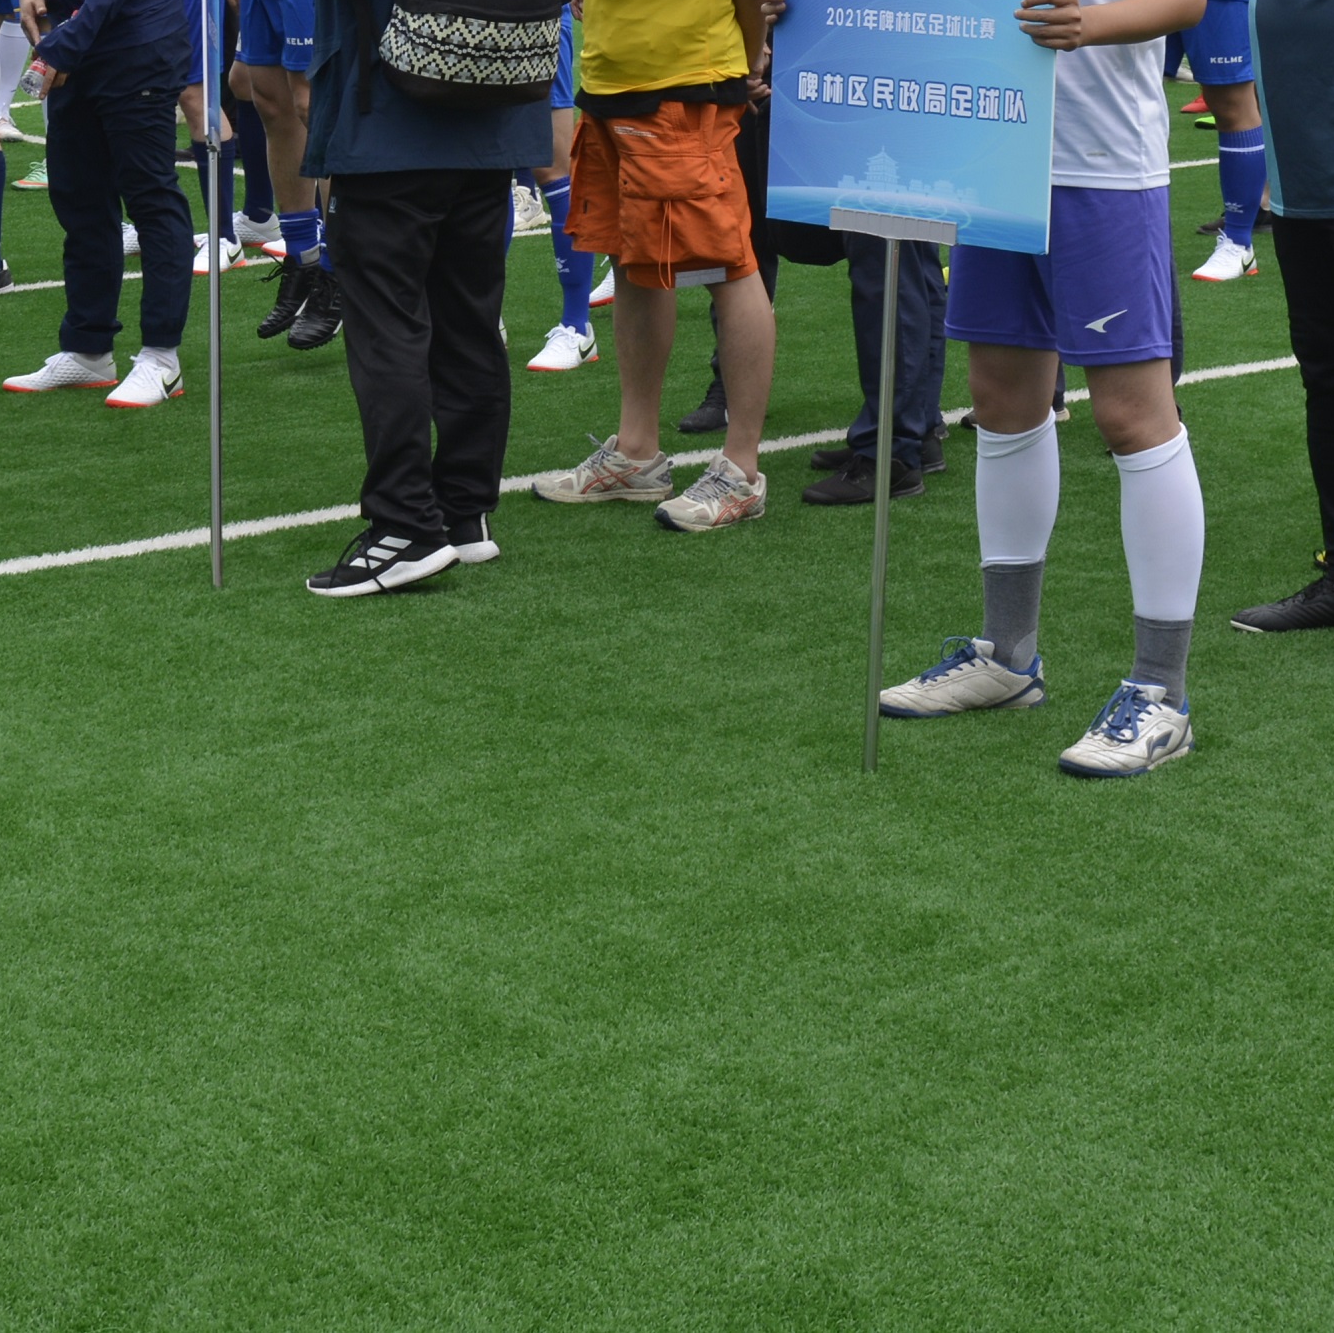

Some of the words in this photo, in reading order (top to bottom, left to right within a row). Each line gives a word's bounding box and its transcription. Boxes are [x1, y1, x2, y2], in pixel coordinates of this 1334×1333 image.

[825, 6, 997, 40] 2021年碑林区足球比赛
[1210, 55, 1244, 64] KELME
[797, 70, 1029, 124] 碑林区民政局足球队
